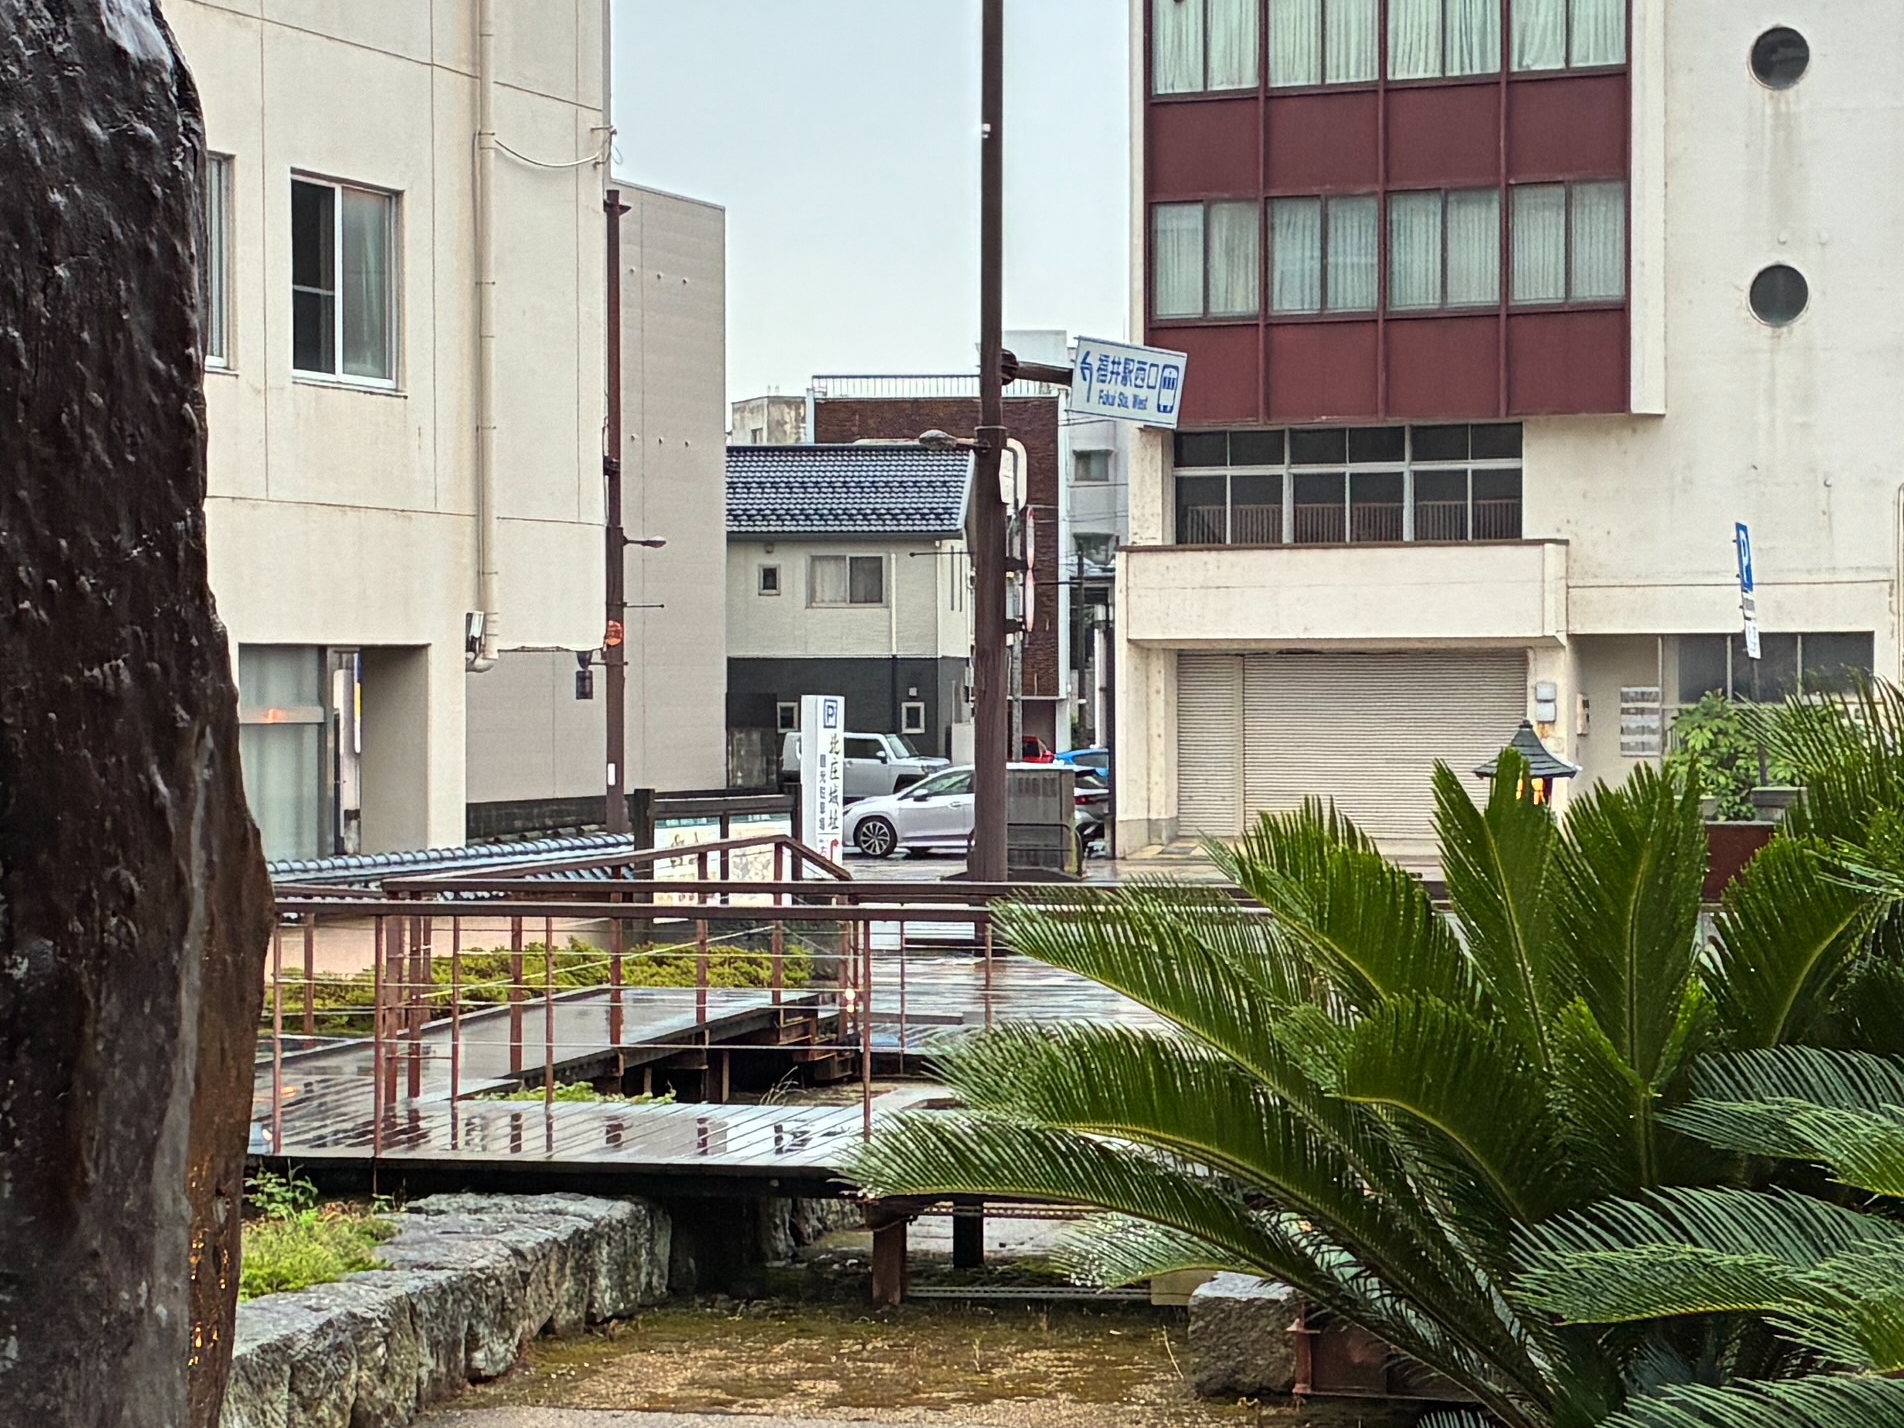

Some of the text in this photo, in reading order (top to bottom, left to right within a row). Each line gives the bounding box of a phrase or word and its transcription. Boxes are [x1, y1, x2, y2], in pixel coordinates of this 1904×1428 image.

[1097, 354, 1159, 389] 福井駅西口
[1739, 529, 1750, 584] P
